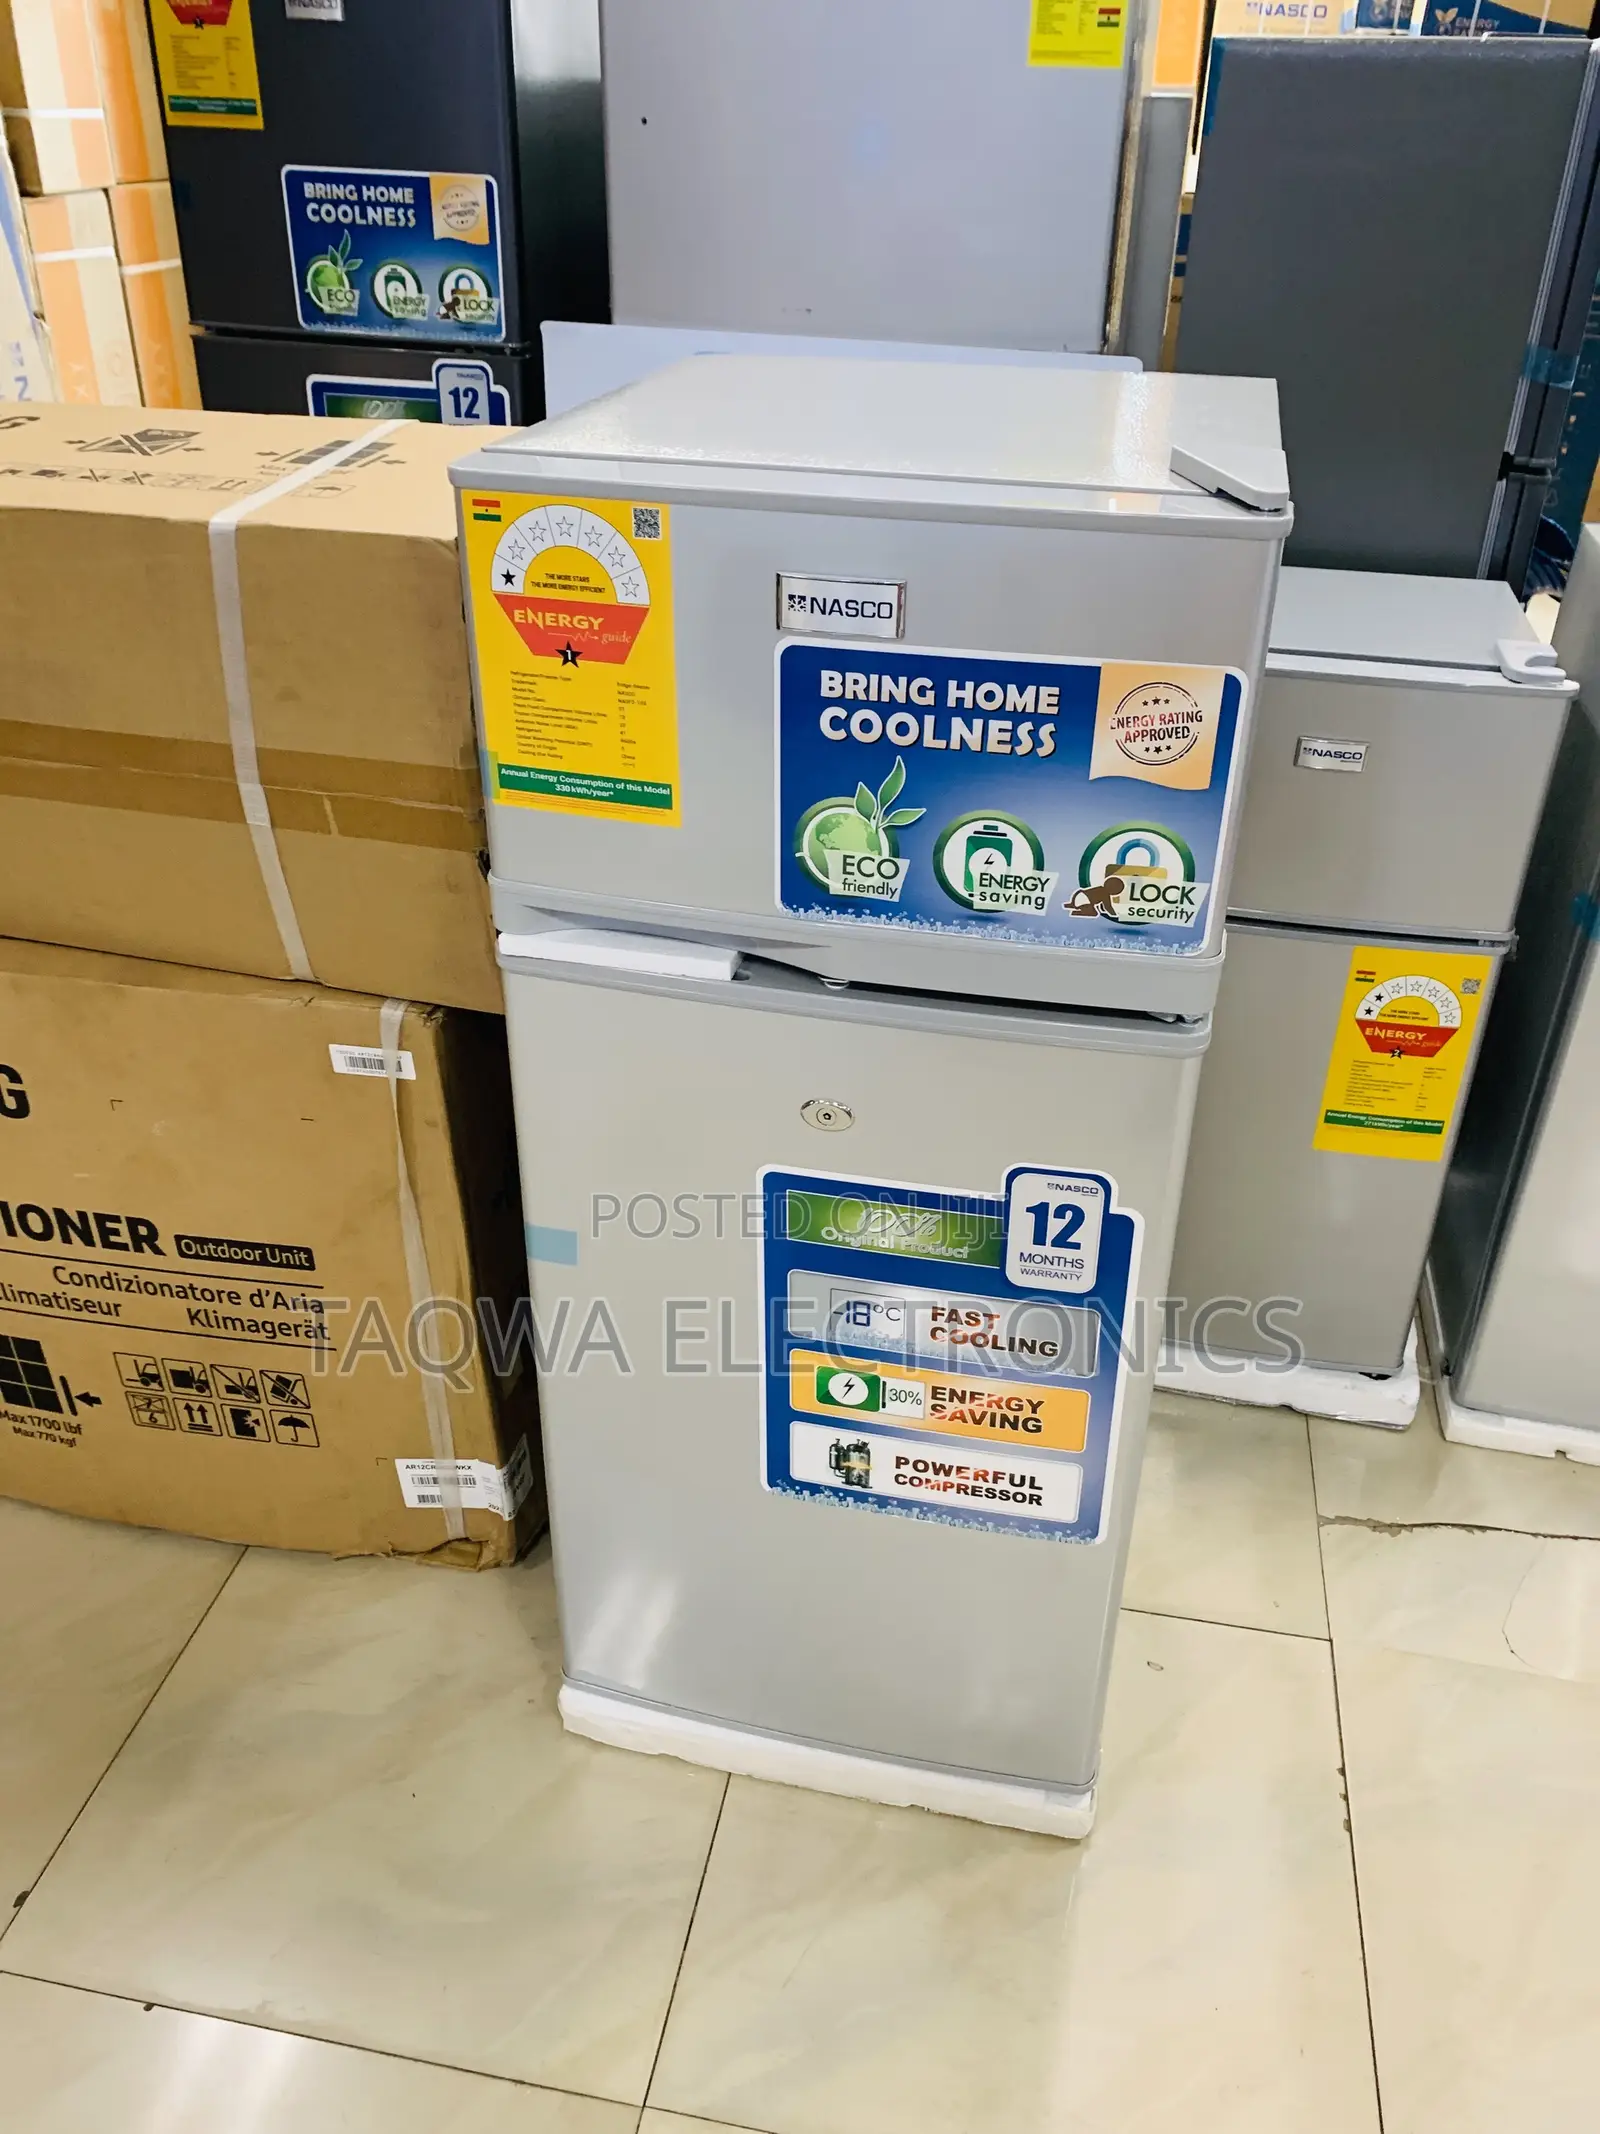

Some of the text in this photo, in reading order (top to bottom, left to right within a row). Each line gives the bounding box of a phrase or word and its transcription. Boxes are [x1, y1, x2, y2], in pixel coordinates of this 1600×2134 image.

[303, 181, 415, 203] BRING HOME
[306, 203, 417, 228] COOLNESS
[327, 288, 356, 303] ECO
[463, 298, 495, 312] LOCK
[448, 386, 480, 419] 12
[513, 607, 604, 630] ENERGY
[809, 596, 893, 620] NASCO
[601, 630, 632, 645] guide
[565, 649, 572, 661] 1
[820, 669, 1061, 715] BRING HOME
[1159, 710, 1203, 726] RATING
[819, 706, 1057, 759] COOLNESS
[1124, 725, 1191, 744] APPROVED
[1312, 748, 1363, 760] NASCO
[500, 768, 671, 796] Annual Energy Consumption of this Model
[554, 784, 571, 793] 330
[841, 853, 900, 881] ECO
[842, 878, 899, 900] friendly
[979, 872, 1051, 894] ENERGY
[1128, 882, 1197, 906] LOCK
[978, 890, 1047, 911] saving
[1127, 904, 1195, 923] security
[1364, 1026, 1428, 1041] ENERGY
[1393, 1049, 1401, 1057] 2
[1053, 1182, 1099, 1195] NASCO
[1025, 1201, 1086, 1250] 12
[180, 1239, 262, 1262] Outdoor
[265, 1248, 310, 1267] Unit
[821, 1226, 969, 1259] Original Product
[1019, 1251, 1085, 1270] MONTHS
[53, 1264, 242, 1306] Condizionatore
[1019, 1267, 1083, 1281] WARRANTY
[186, 1307, 331, 1342] Klimagerät
[931, 1306, 1001, 1330] FAST
[930, 1326, 1059, 1357] COOLING
[888, 1388, 922, 1406] 30%
[930, 1385, 1045, 1414] ENERGY
[27, 1415, 61, 1431] 1700
[63, 1420, 82, 1436] lbf
[930, 1403, 1043, 1434] SAVING
[36, 1430, 57, 1443] 770
[895, 1455, 1044, 1491] POWERFUL
[894, 1473, 1043, 1507] COMPRESSOR
